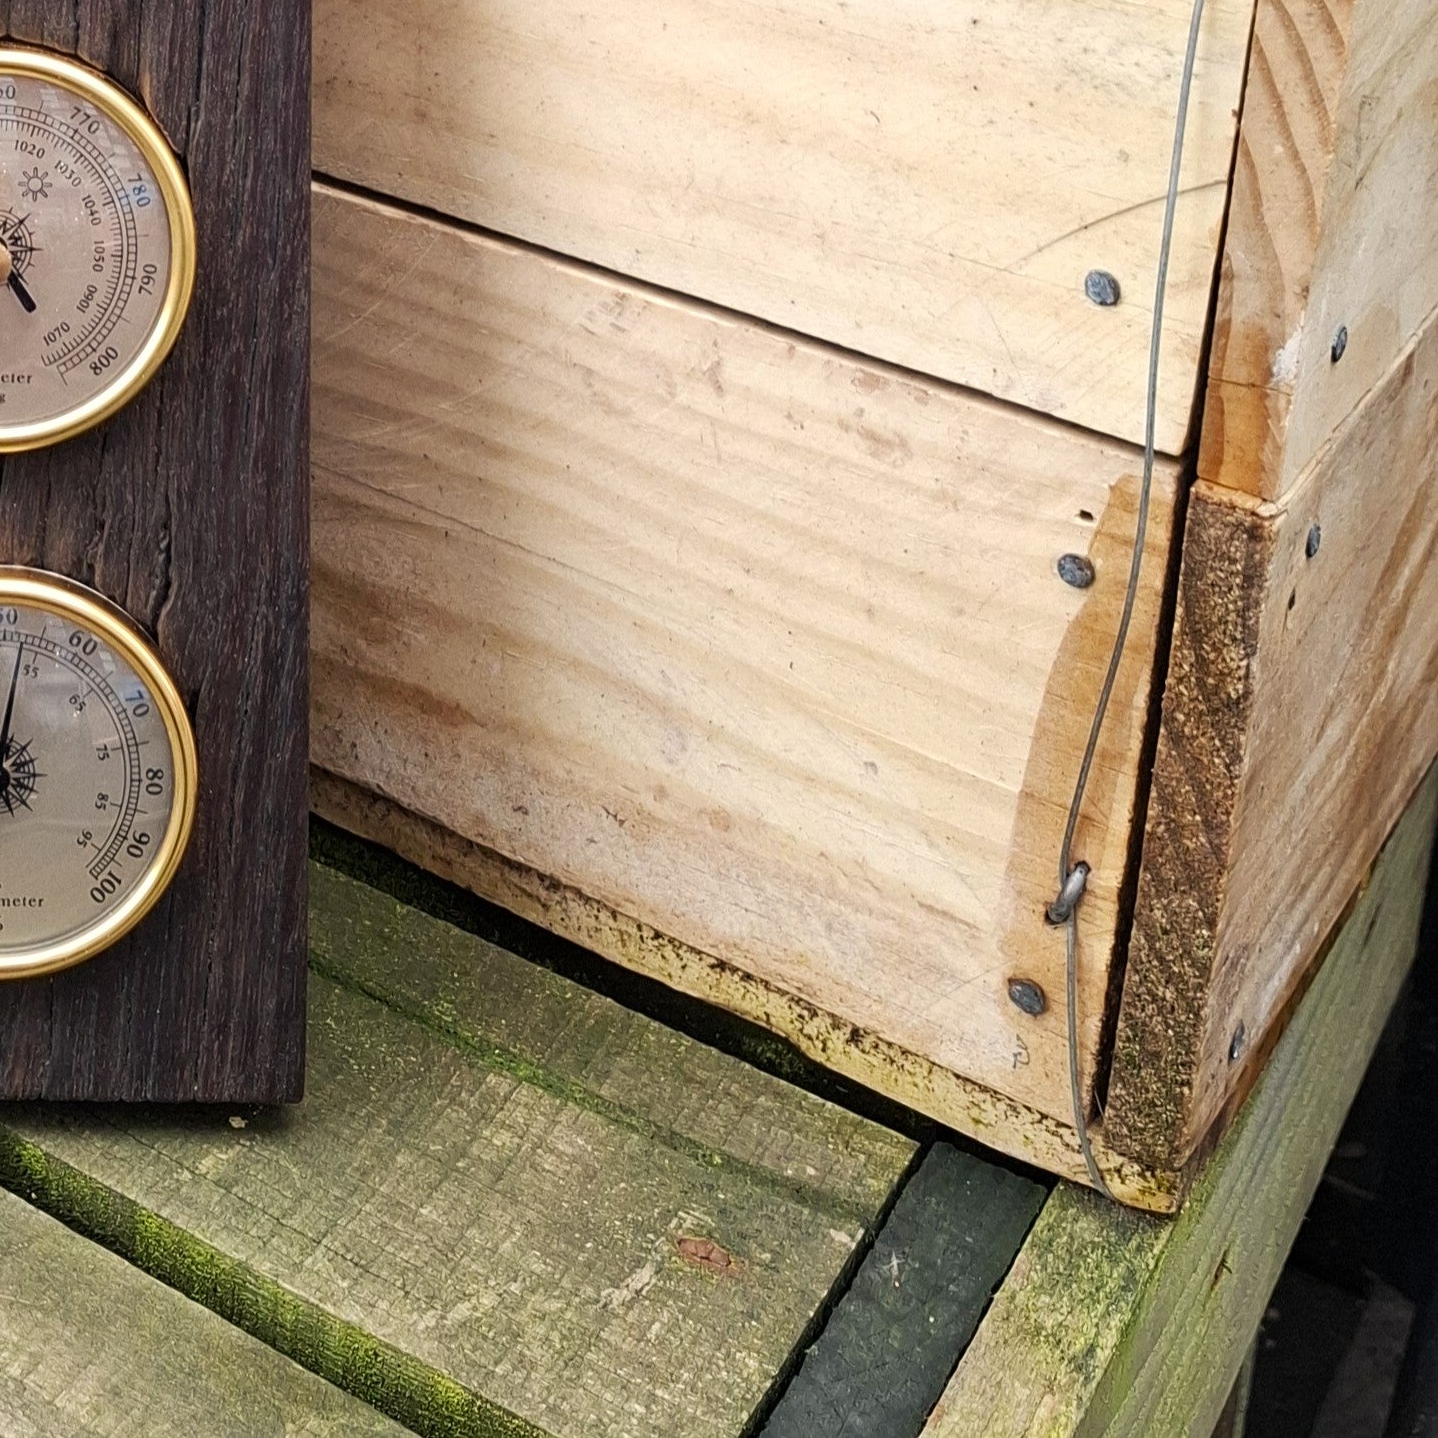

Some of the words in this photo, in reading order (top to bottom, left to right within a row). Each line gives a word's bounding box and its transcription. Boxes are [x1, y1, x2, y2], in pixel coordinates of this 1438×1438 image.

[69, 107, 99, 135] 770
[14, 140, 45, 158] 1020
[55, 160, 81, 187] 1030
[127, 174, 150, 207] 780
[81, 194, 101, 226] 1040
[94, 240, 103, 272] 1050
[139, 264, 157, 296] 790
[76, 284, 97, 313] 1060
[43, 321, 70, 346] 1070
[89, 346, 119, 376] 800
[69, 630, 97, 656] 60
[23, 665, 39, 678] 55
[69, 694, 86, 713] 65
[125, 690, 149, 717] 70
[96, 745, 109, 761] 75
[146, 769, 163, 795] 80
[94, 793, 109, 810] 85
[77, 829, 92, 848] 95
[127, 832, 150, 858] 90
[90, 872, 121, 903] 100
